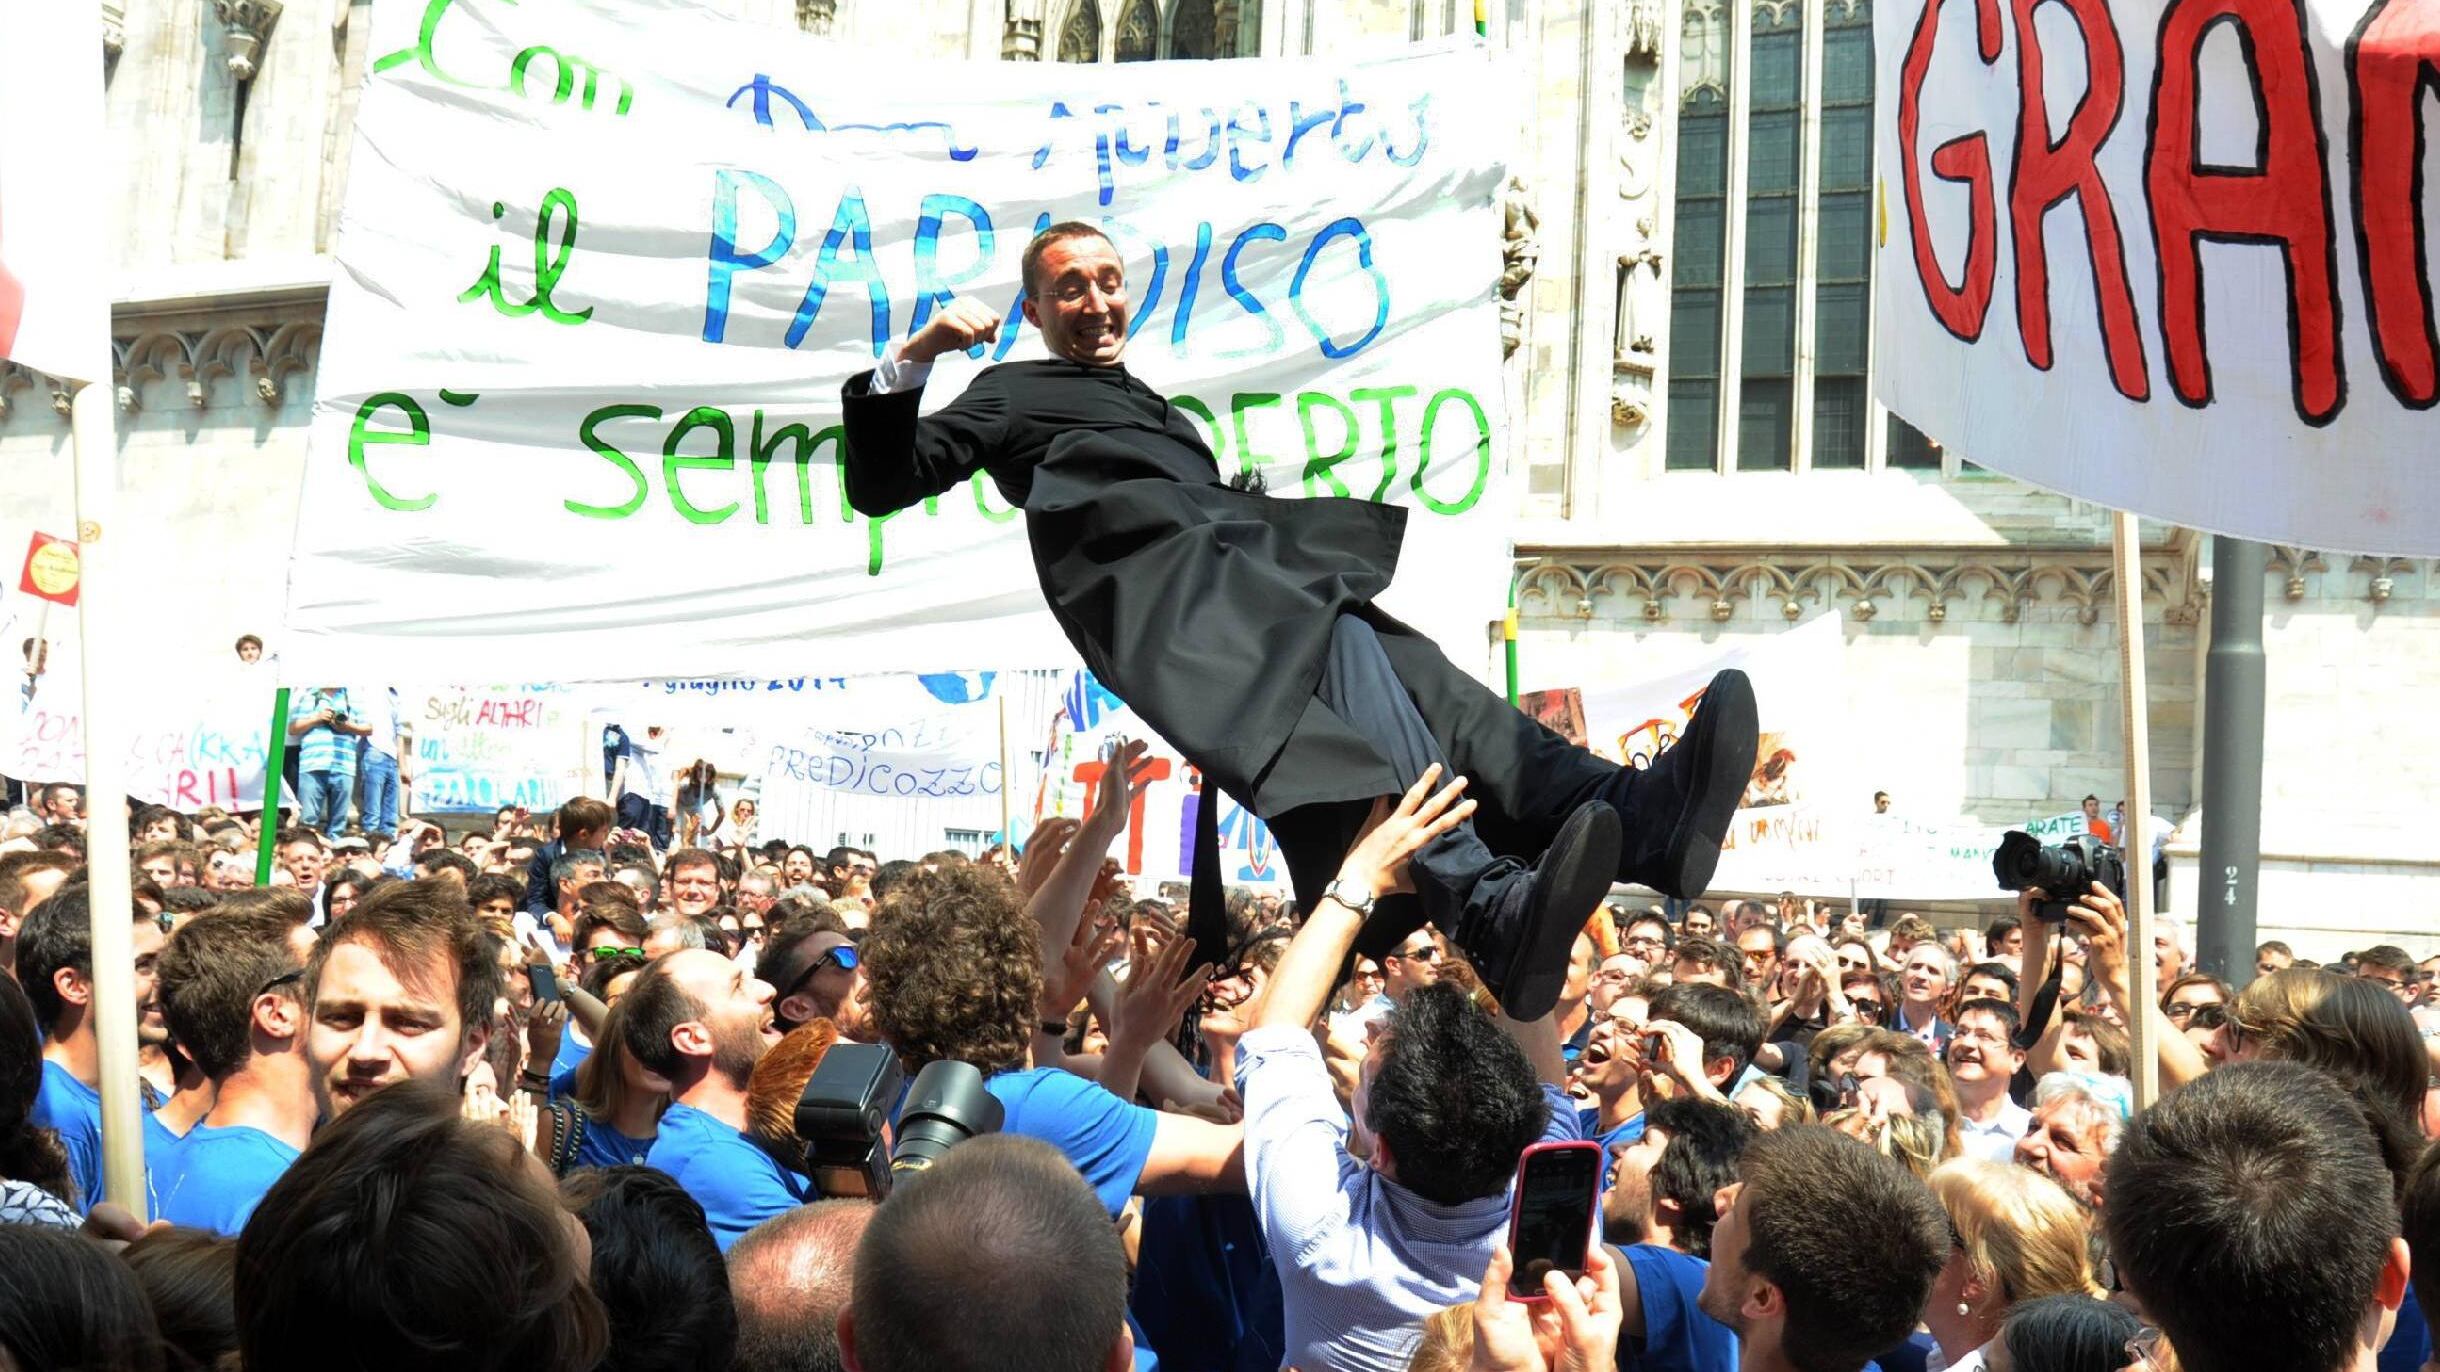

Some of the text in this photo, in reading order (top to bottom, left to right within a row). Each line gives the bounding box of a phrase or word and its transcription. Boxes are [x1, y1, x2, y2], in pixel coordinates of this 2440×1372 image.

[456, 168, 1389, 360] il PARDISO
[564, 403, 1018, 576] sem
